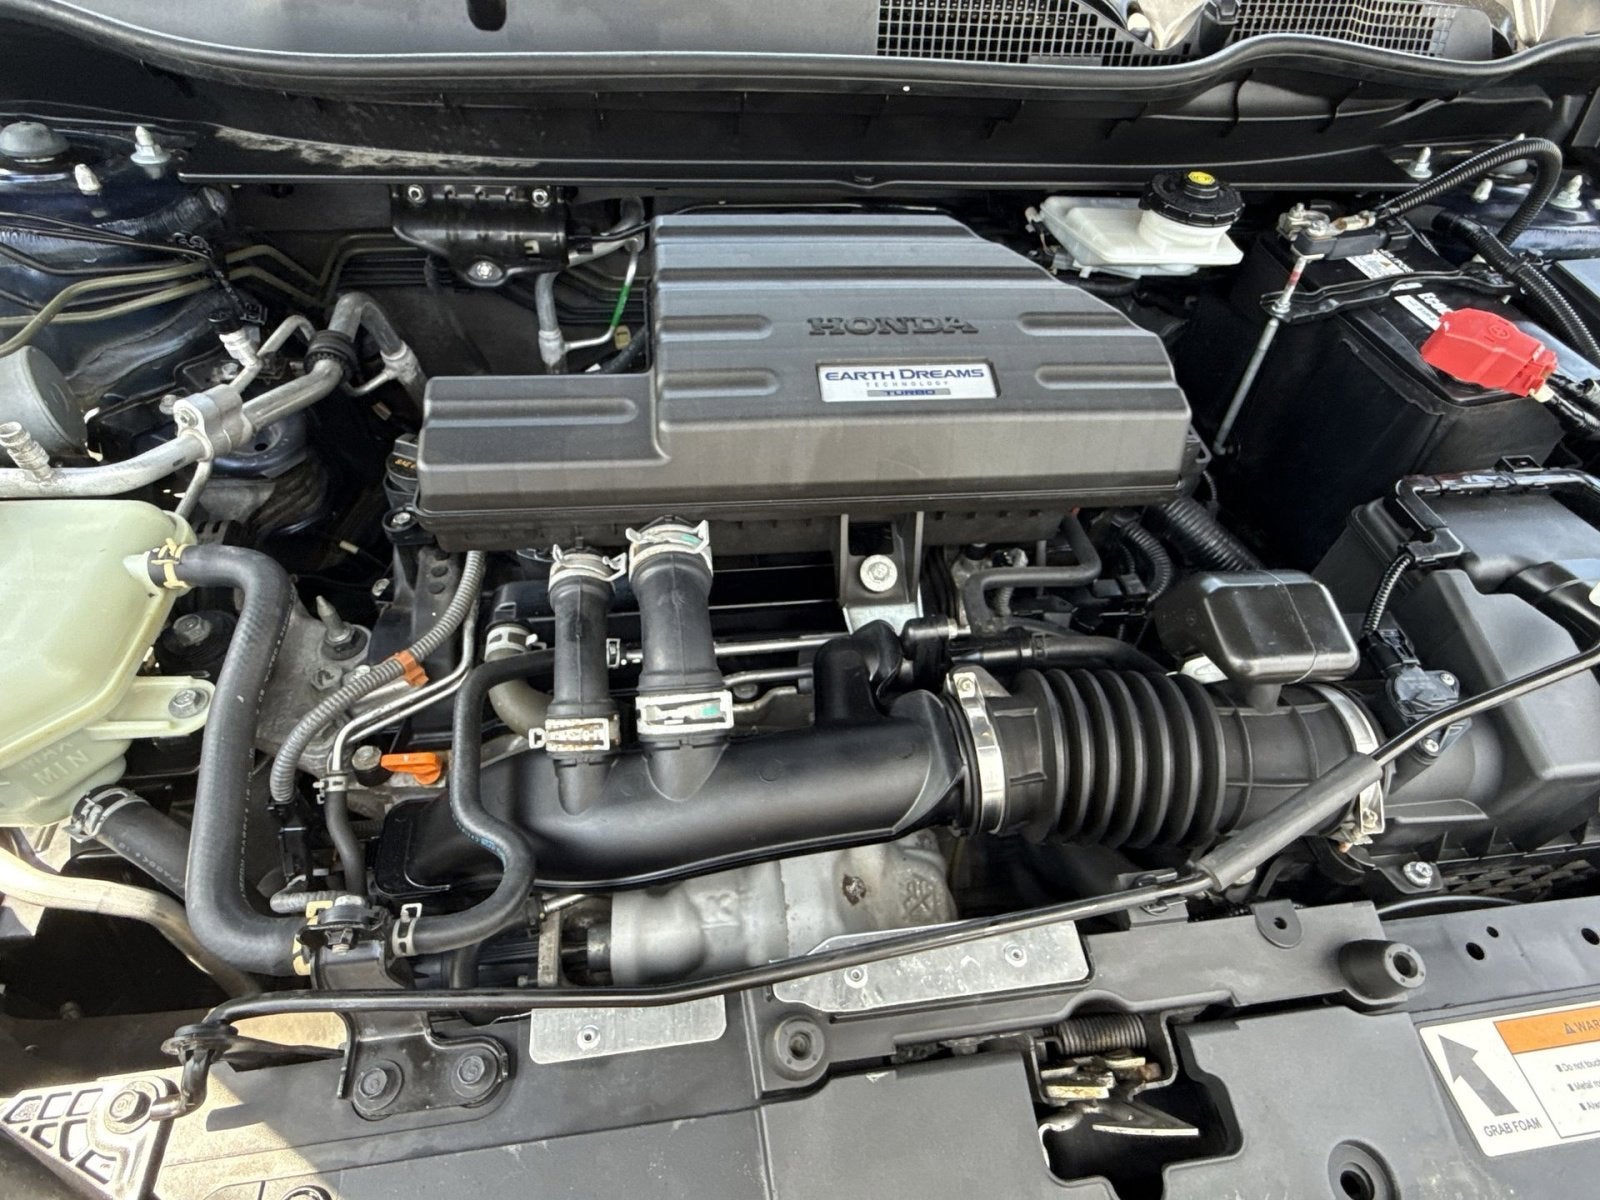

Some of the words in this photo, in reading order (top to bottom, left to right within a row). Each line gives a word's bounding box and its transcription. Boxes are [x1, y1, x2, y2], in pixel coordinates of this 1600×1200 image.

[807, 316, 979, 336] HONDA
[825, 370, 895, 381] EARTH
[900, 368, 985, 379] DREAMS
[884, 388, 936, 396] TURBO
[32, 750, 89, 786] MIN
[1483, 1122, 1513, 1137] GRAB
[1513, 1117, 1542, 1132] FOAM
